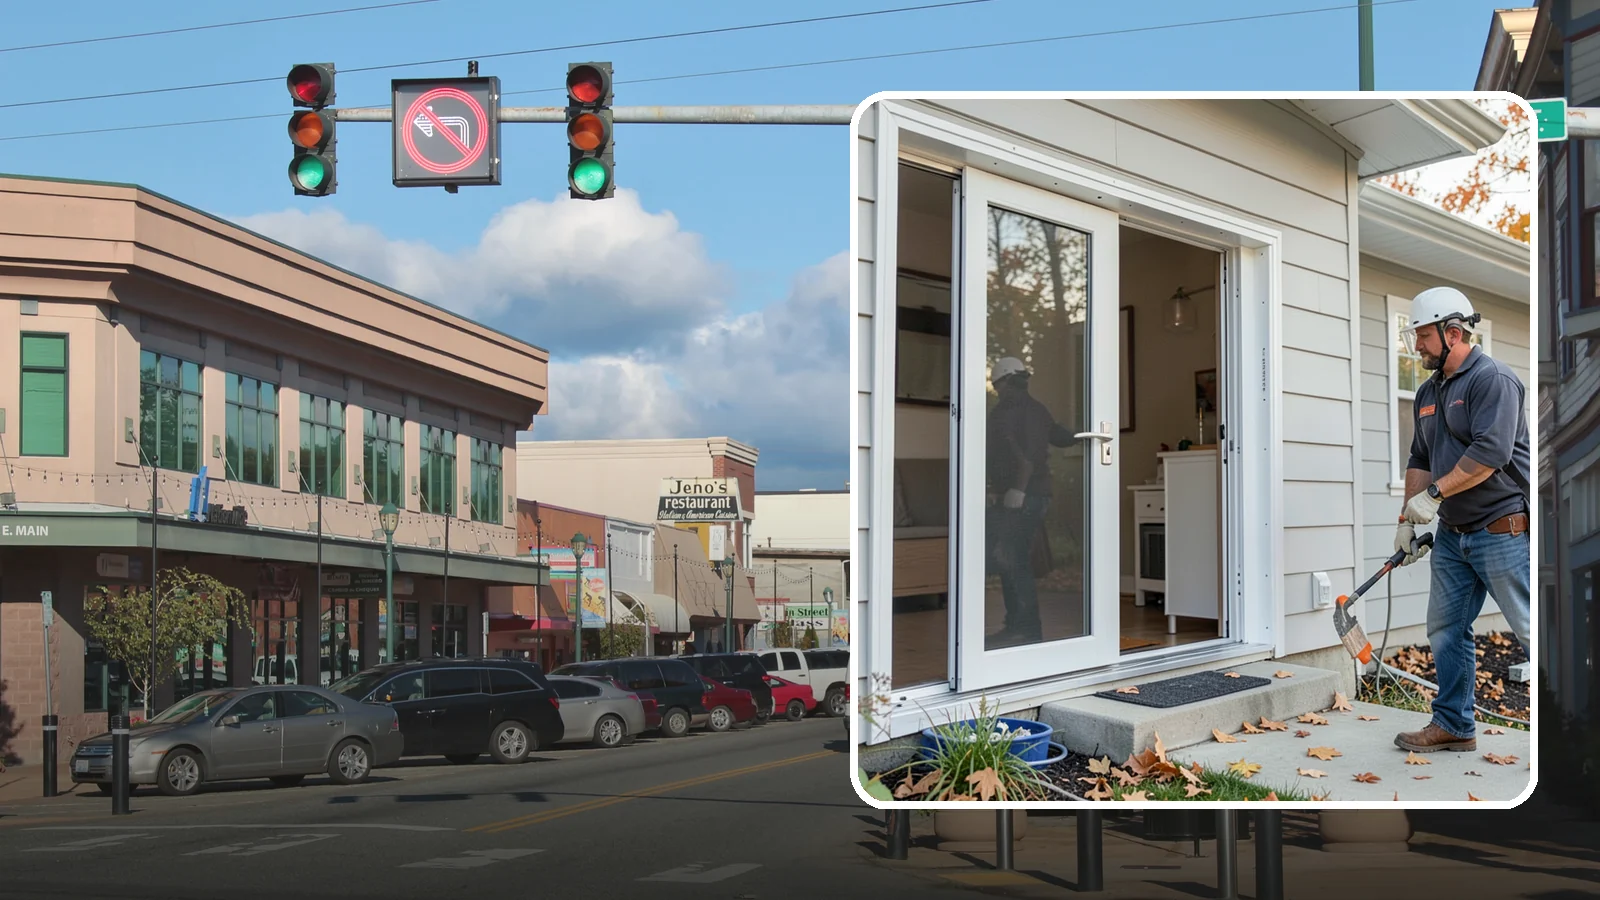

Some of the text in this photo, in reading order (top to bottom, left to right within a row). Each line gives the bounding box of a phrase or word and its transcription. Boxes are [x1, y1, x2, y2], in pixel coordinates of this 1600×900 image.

[670, 480, 727, 494] Jeno's
[665, 496, 731, 509] restaurant
[658, 510, 681, 519] Italian
[686, 510, 714, 519] American
[715, 509, 737, 519] Cuisine
[2, 525, 49, 536] E. MAIN
[797, 607, 828, 616] Street
